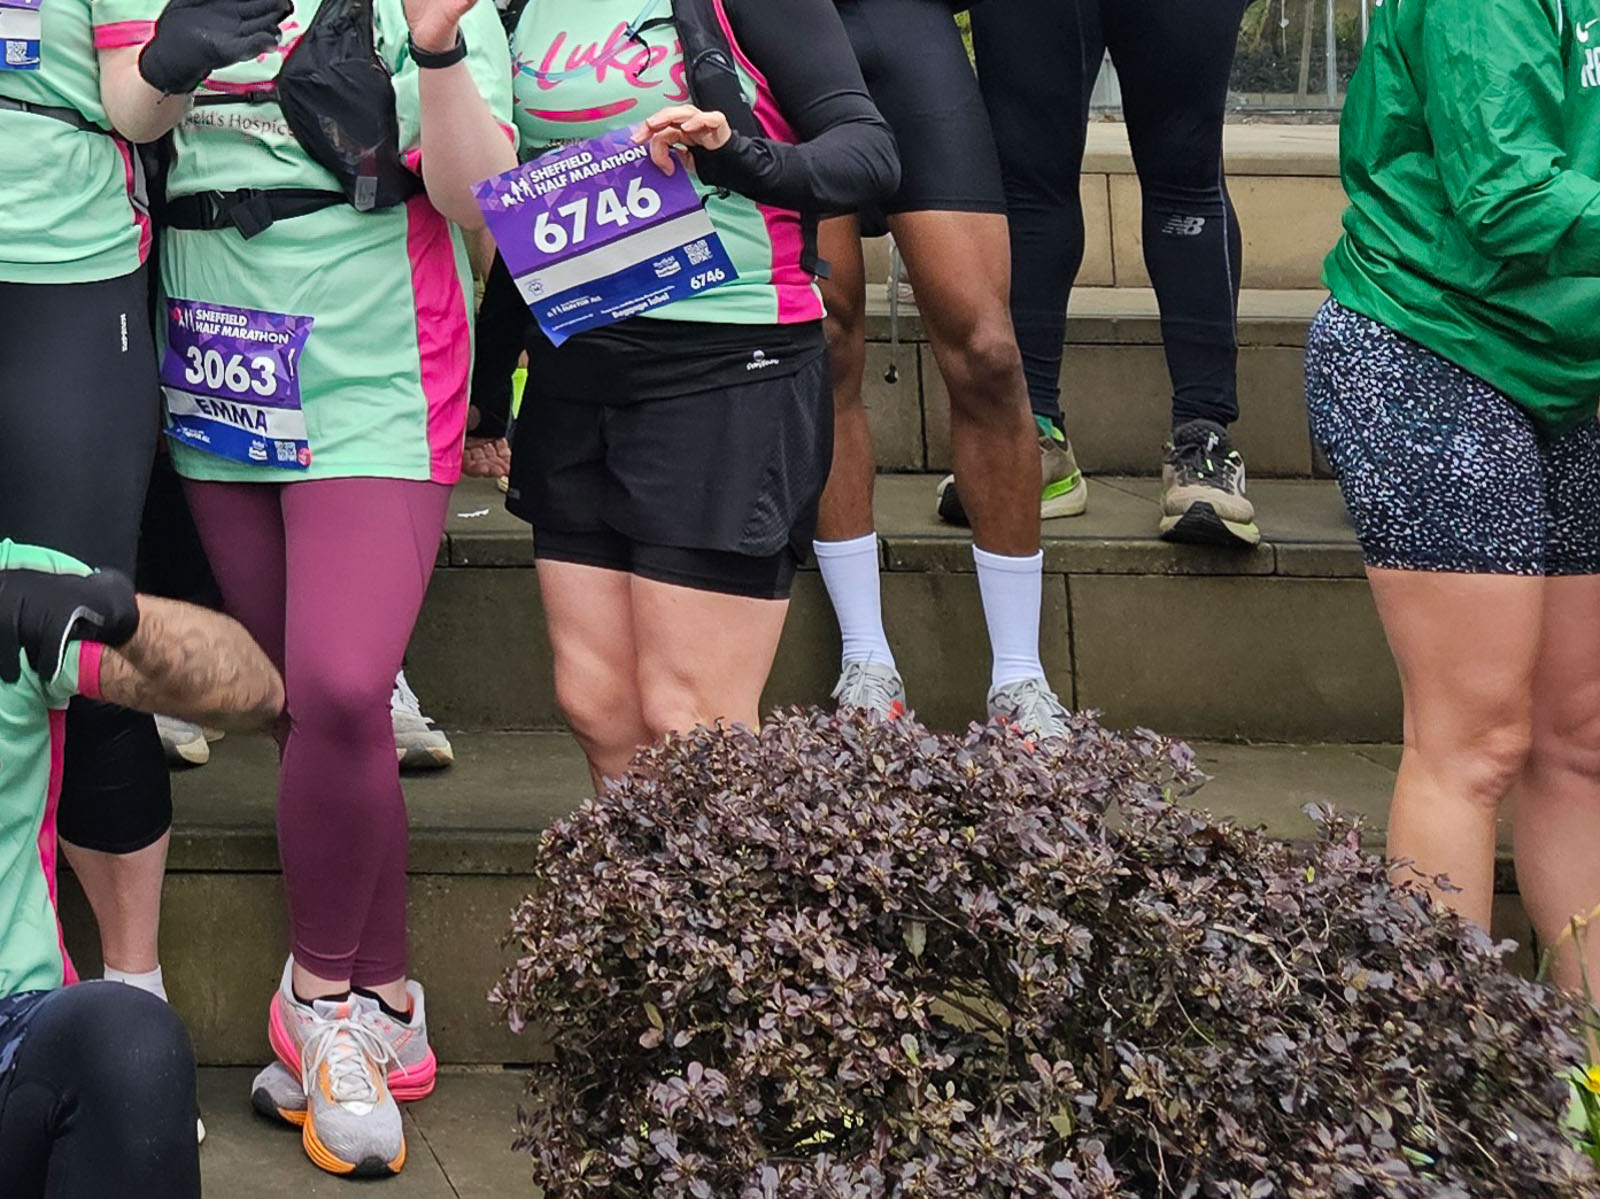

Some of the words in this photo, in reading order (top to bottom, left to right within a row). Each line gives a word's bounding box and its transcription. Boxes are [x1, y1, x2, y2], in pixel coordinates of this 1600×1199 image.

[536, 21, 690, 103] Luke's
[530, 151, 593, 183] SHEFFIELD
[534, 173, 568, 197] HALF
[570, 145, 648, 182] MARATHON
[533, 176, 662, 254] 6746
[690, 268, 726, 291] 6746
[195, 309, 248, 327] SHEFFIELD
[195, 322, 220, 335] HALF
[221, 325, 290, 345] MARATHON
[184, 345, 278, 397] 3063
[195, 398, 268, 434] EMMA
